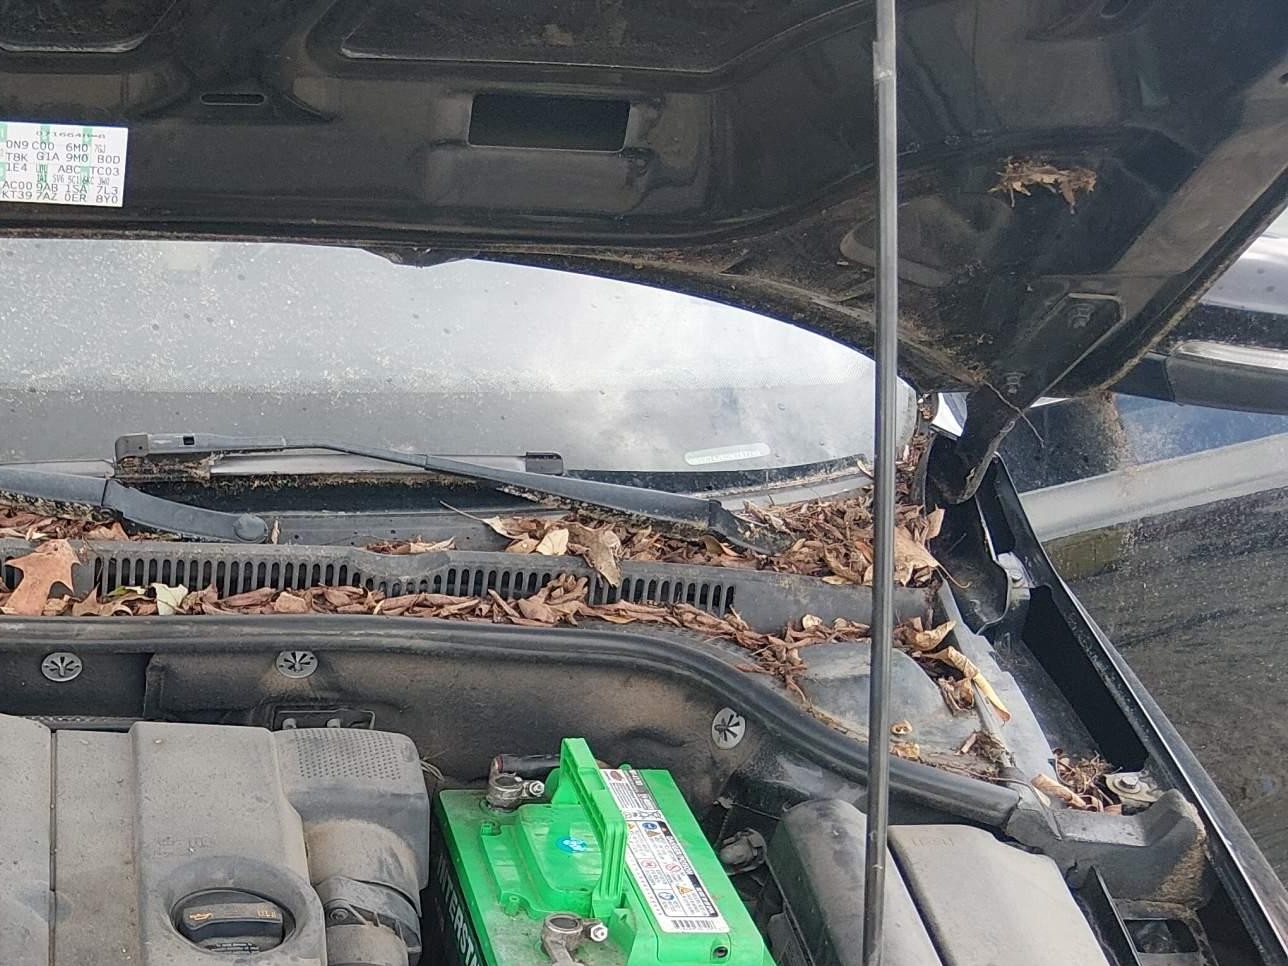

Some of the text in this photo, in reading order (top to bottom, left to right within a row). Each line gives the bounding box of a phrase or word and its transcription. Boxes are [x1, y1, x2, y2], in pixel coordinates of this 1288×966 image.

[6, 140, 29, 150] 0N9
[66, 143, 89, 152] 6M0
[5, 152, 29, 162] T8K
[36, 152, 60, 161] G1A
[66, 153, 89, 163] 9M0
[6, 163, 28, 172] 1E4
[36, 182, 58, 193] 9AB
